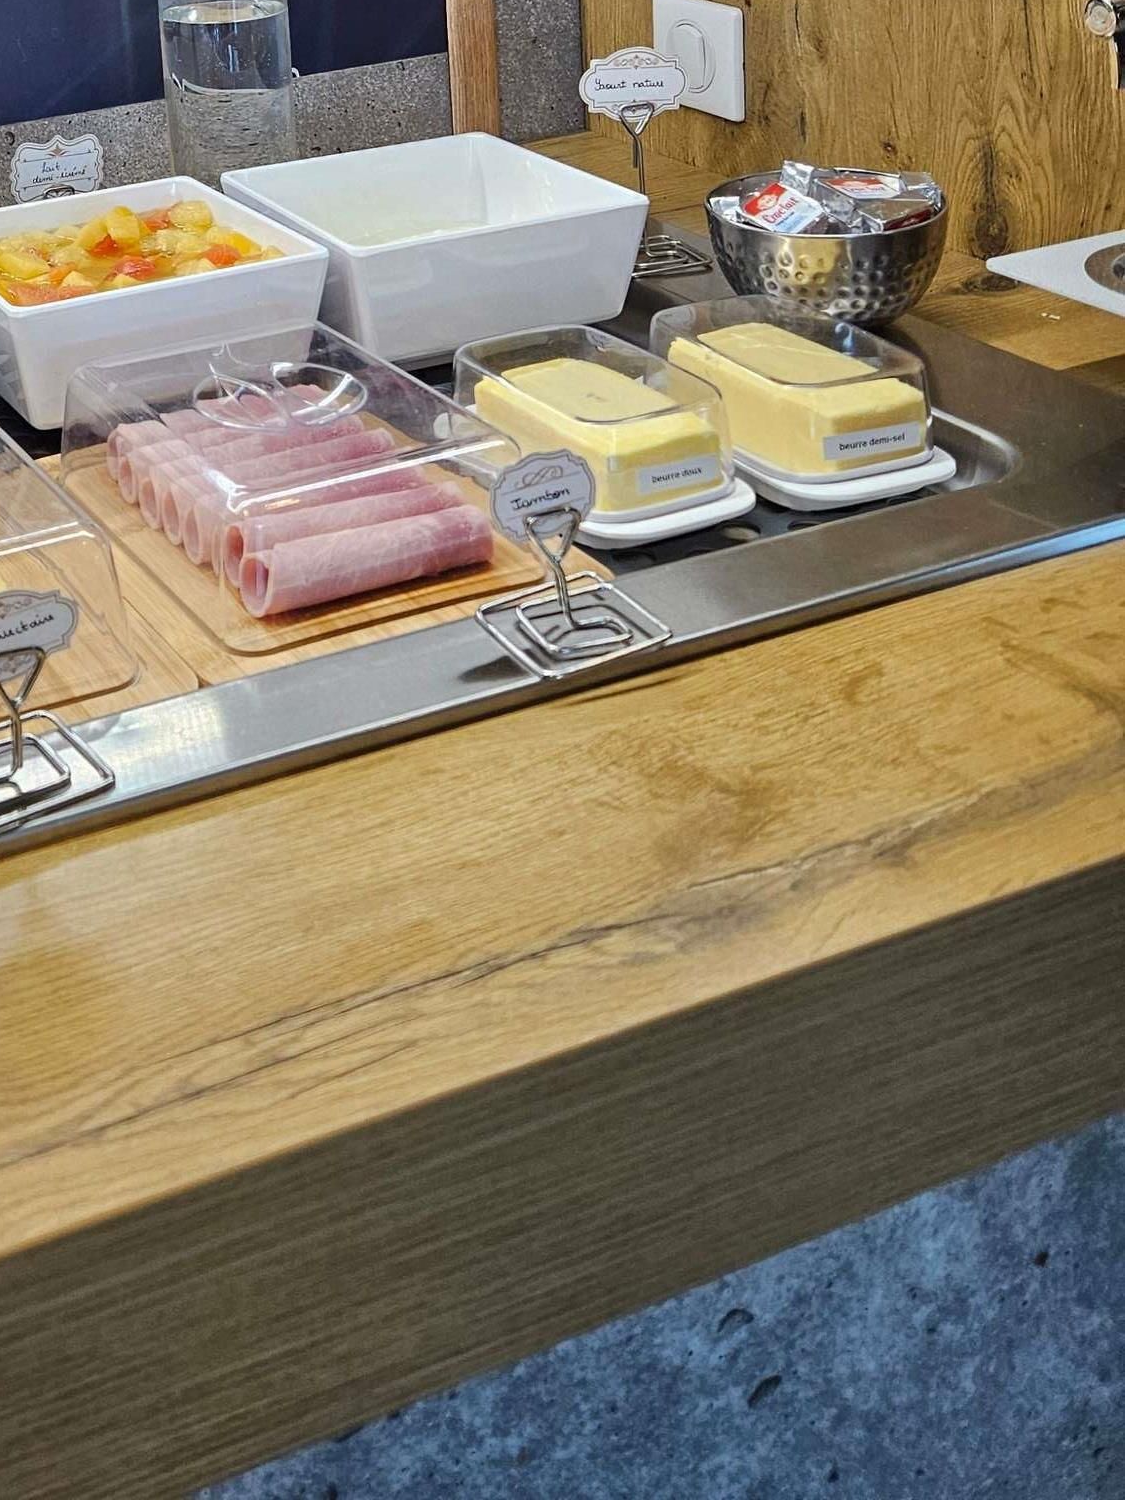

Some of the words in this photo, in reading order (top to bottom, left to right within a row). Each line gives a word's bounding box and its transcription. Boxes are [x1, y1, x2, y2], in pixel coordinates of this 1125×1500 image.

[839, 439, 868, 451] beurre
[869, 432, 906, 446] demi-sel
[651, 471, 680, 484] beurre
[510, 487, 571, 511] Jambon
